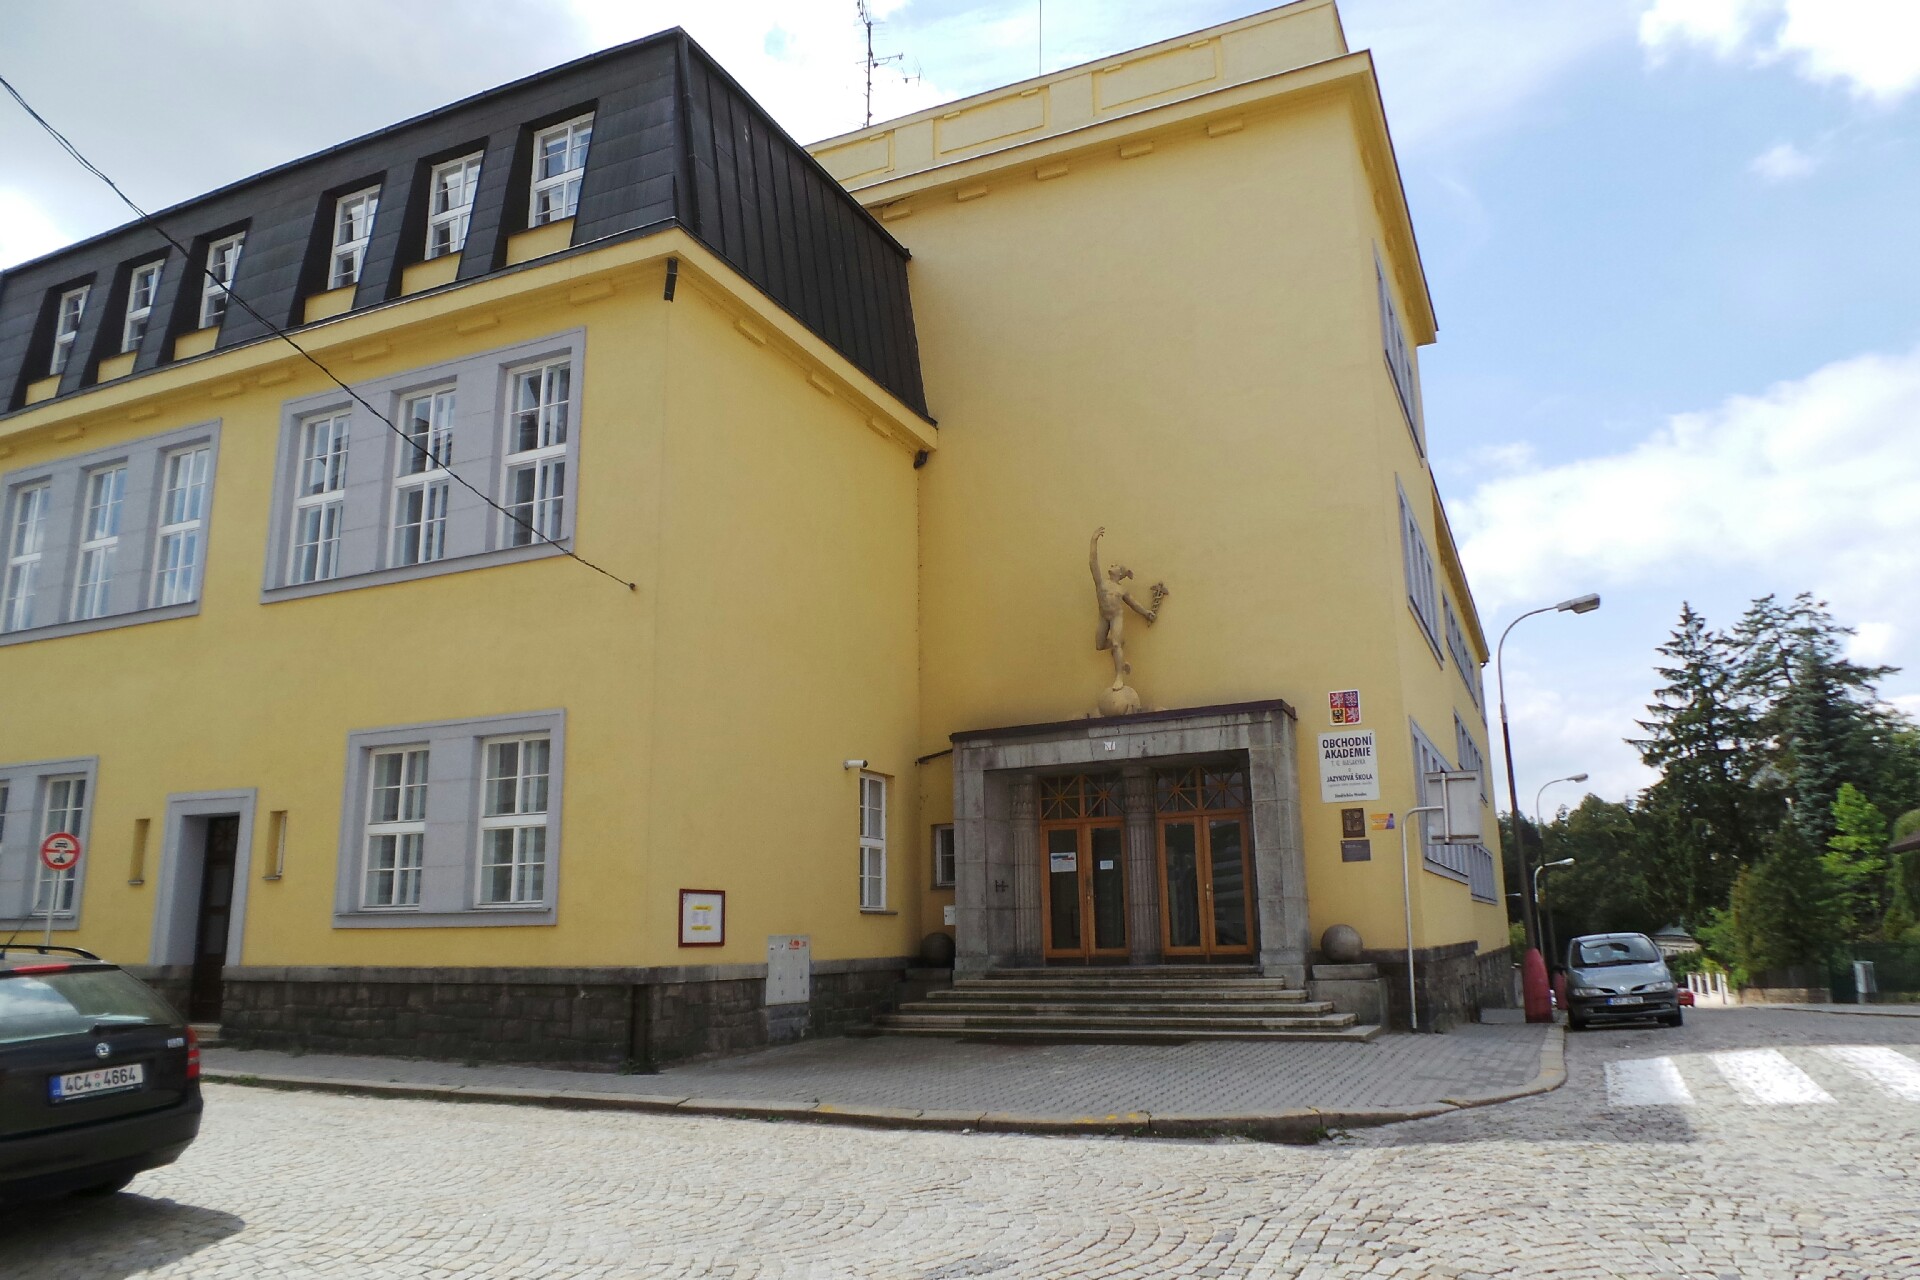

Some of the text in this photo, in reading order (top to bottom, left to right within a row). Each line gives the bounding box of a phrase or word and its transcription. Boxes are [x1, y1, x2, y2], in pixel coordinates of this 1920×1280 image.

[1322, 733, 1372, 748] OBCHODNÍ
[1325, 747, 1371, 759] AKADEMIE
[1327, 772, 1354, 782] JAZYKOVÁ
[65, 1067, 136, 1092] 4C4 4664
